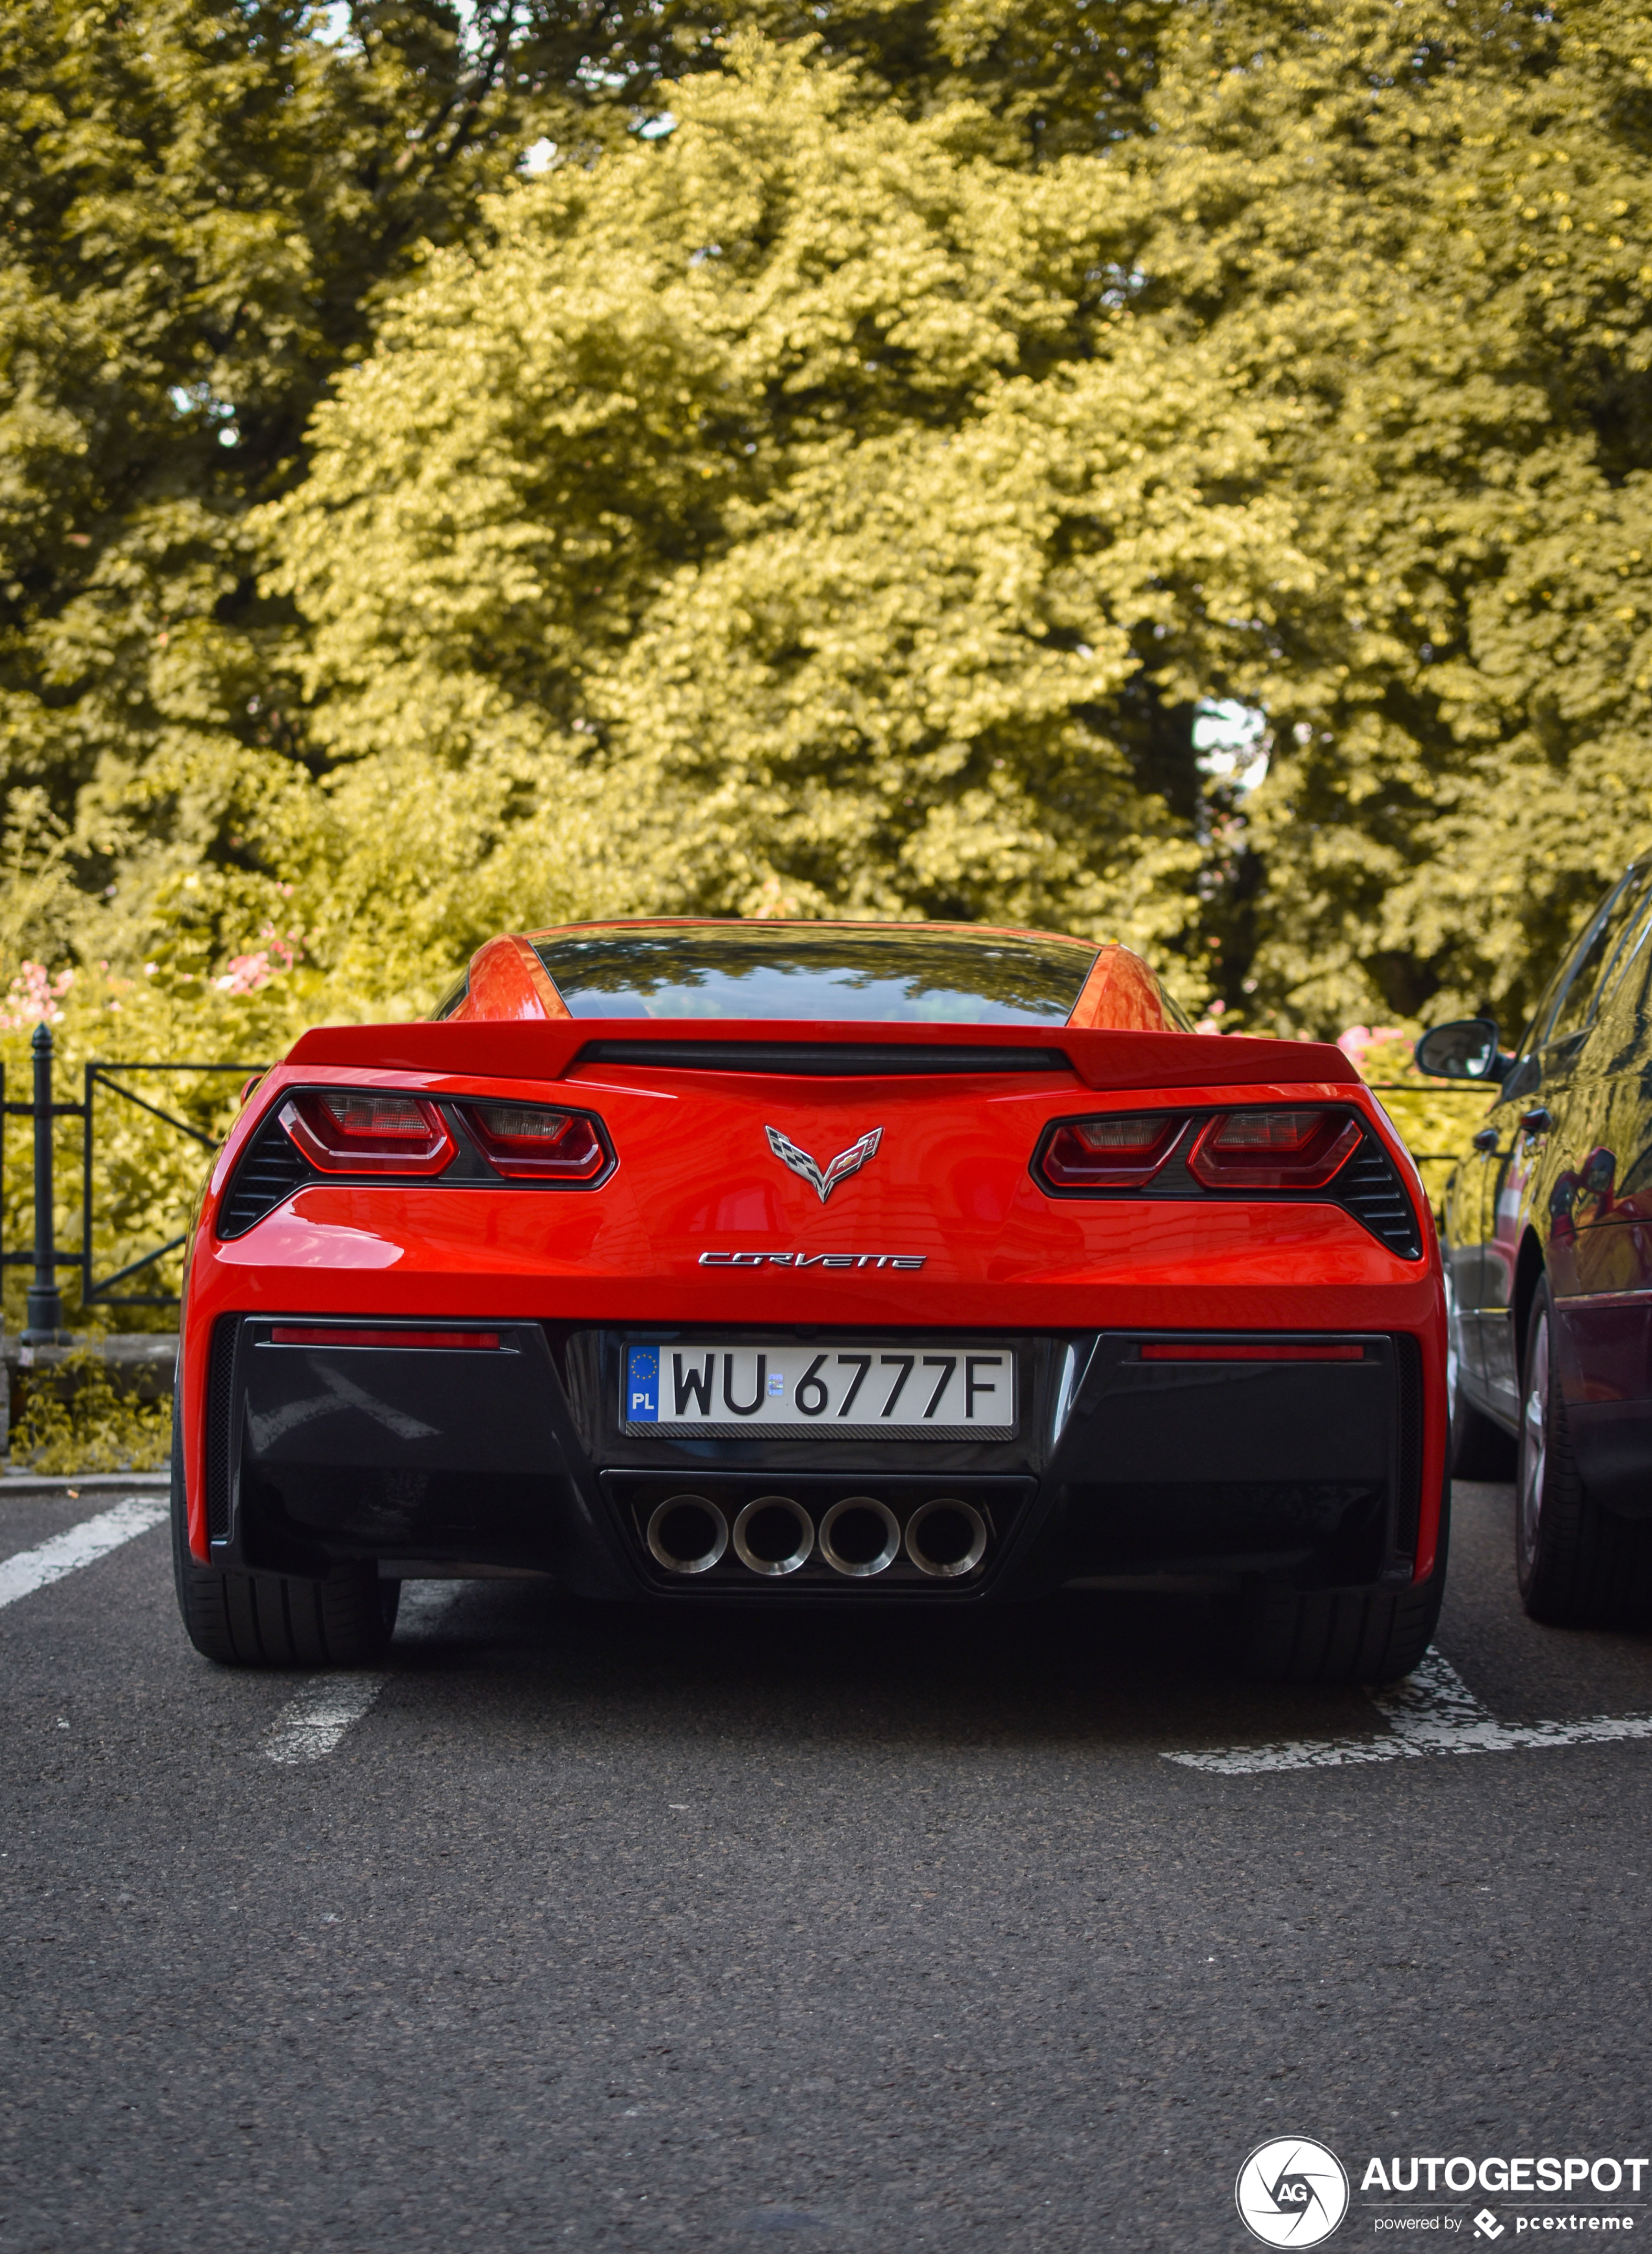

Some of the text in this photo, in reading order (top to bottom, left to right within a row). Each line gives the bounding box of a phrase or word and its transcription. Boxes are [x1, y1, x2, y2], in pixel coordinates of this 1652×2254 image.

[699, 1252, 927, 1268] CORVETTE
[672, 1353, 1002, 1418] WU 6777F
[632, 1393, 654, 1410] PL
